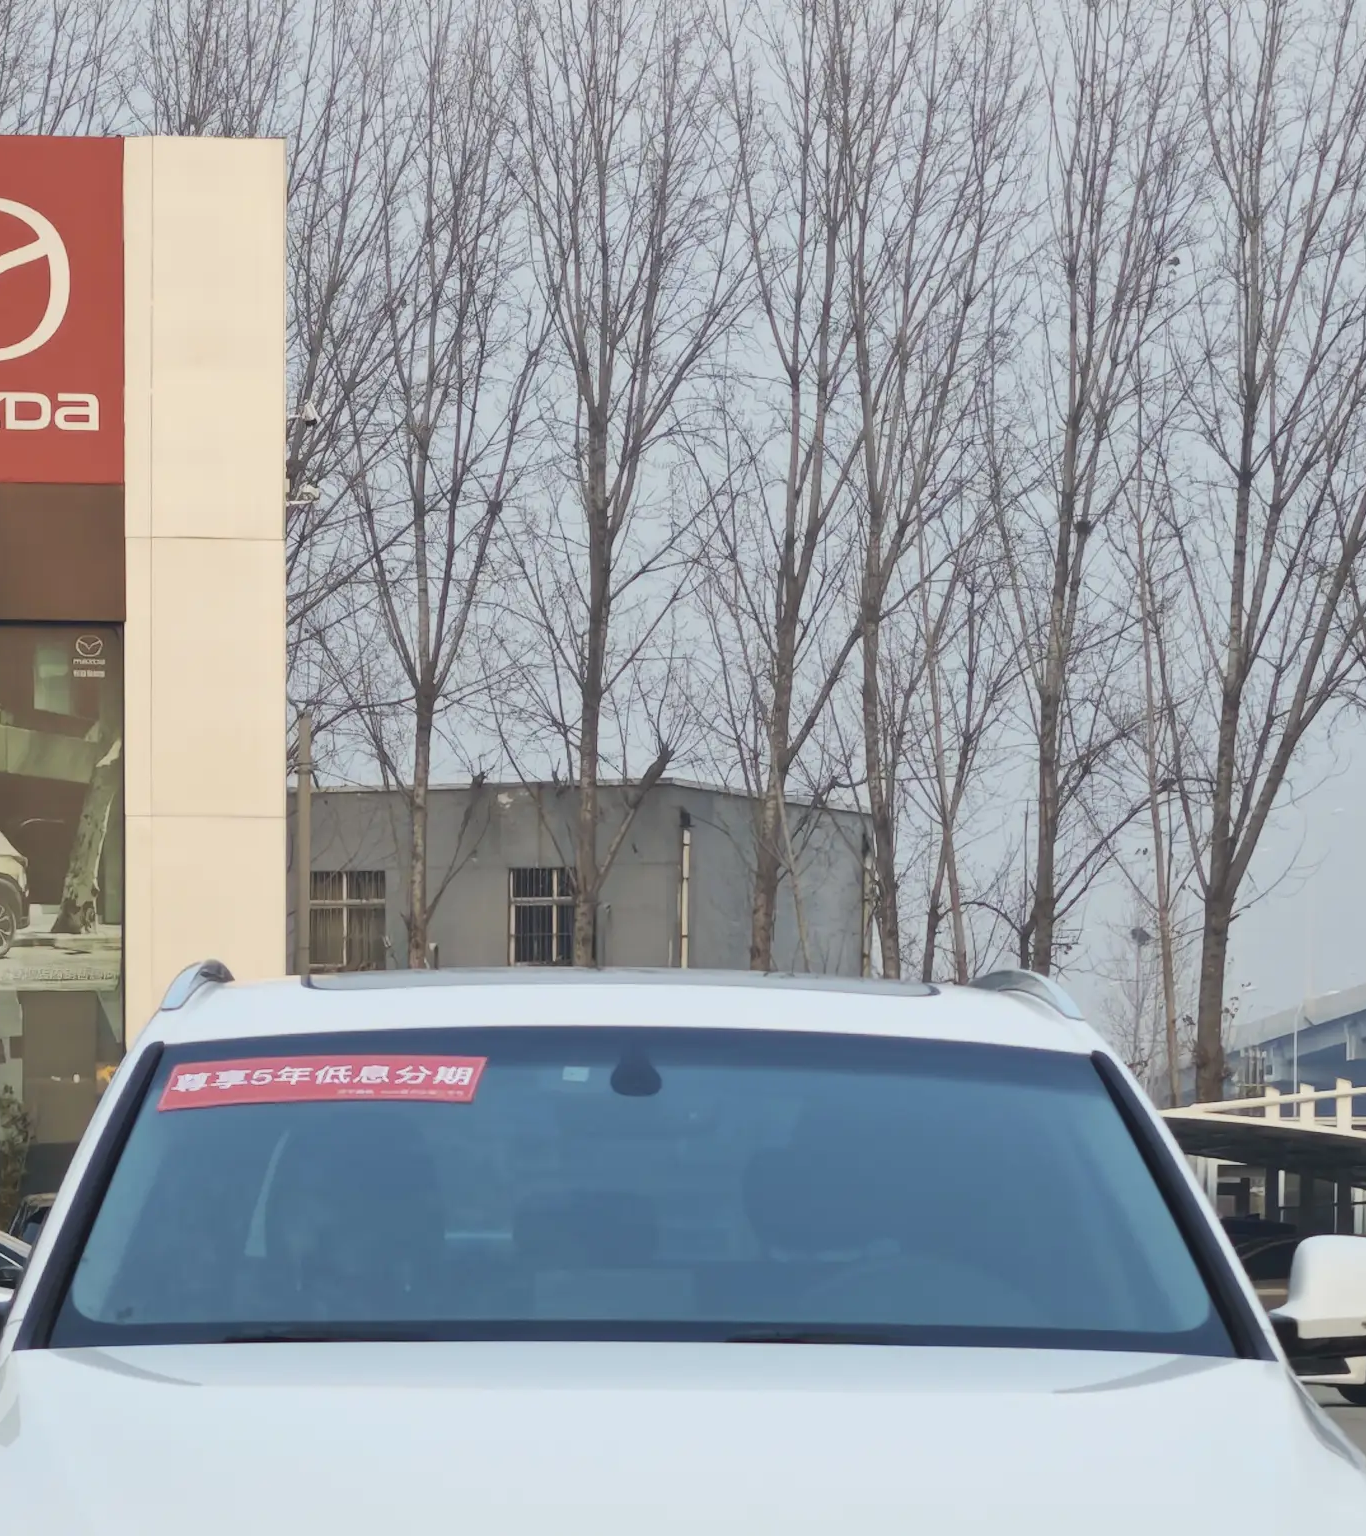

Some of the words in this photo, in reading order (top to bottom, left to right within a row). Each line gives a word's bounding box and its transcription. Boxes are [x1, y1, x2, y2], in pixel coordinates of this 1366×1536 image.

[171, 1065, 475, 1092] 尊享5年低息分期
